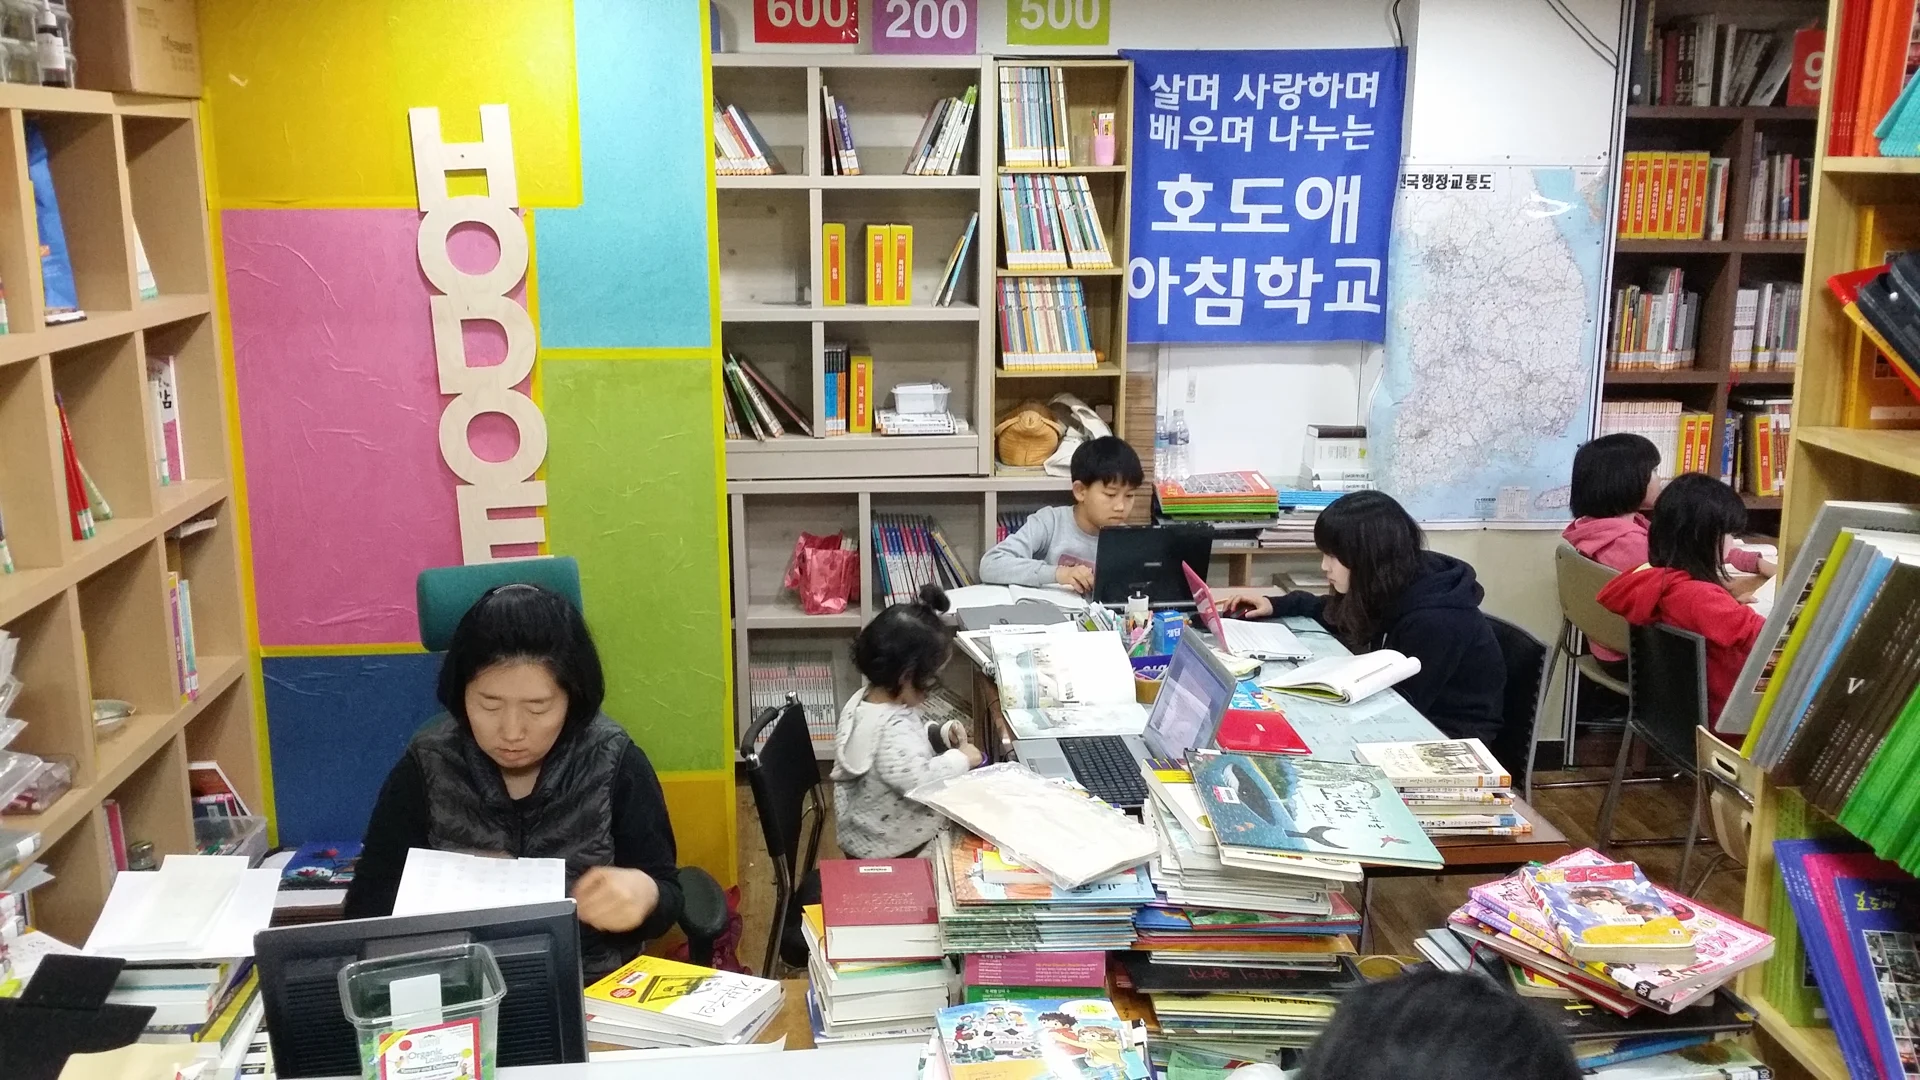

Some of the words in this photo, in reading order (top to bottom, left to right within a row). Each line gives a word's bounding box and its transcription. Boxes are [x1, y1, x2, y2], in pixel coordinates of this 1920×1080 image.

[767, 0, 848, 28] 600
[885, 0, 968, 39] 200
[1020, 0, 1101, 31] 500
[1149, 72, 1221, 111] 살며
[1233, 70, 1381, 112] 사랑하며
[1149, 113, 1254, 152] 배우며
[1268, 114, 1375, 152] 나누는
[1150, 172, 1362, 245] 호도애
[1127, 254, 1382, 326] 아침학교
[407, 103, 555, 566] HODOE
[408, 1048, 443, 1060] Organic
